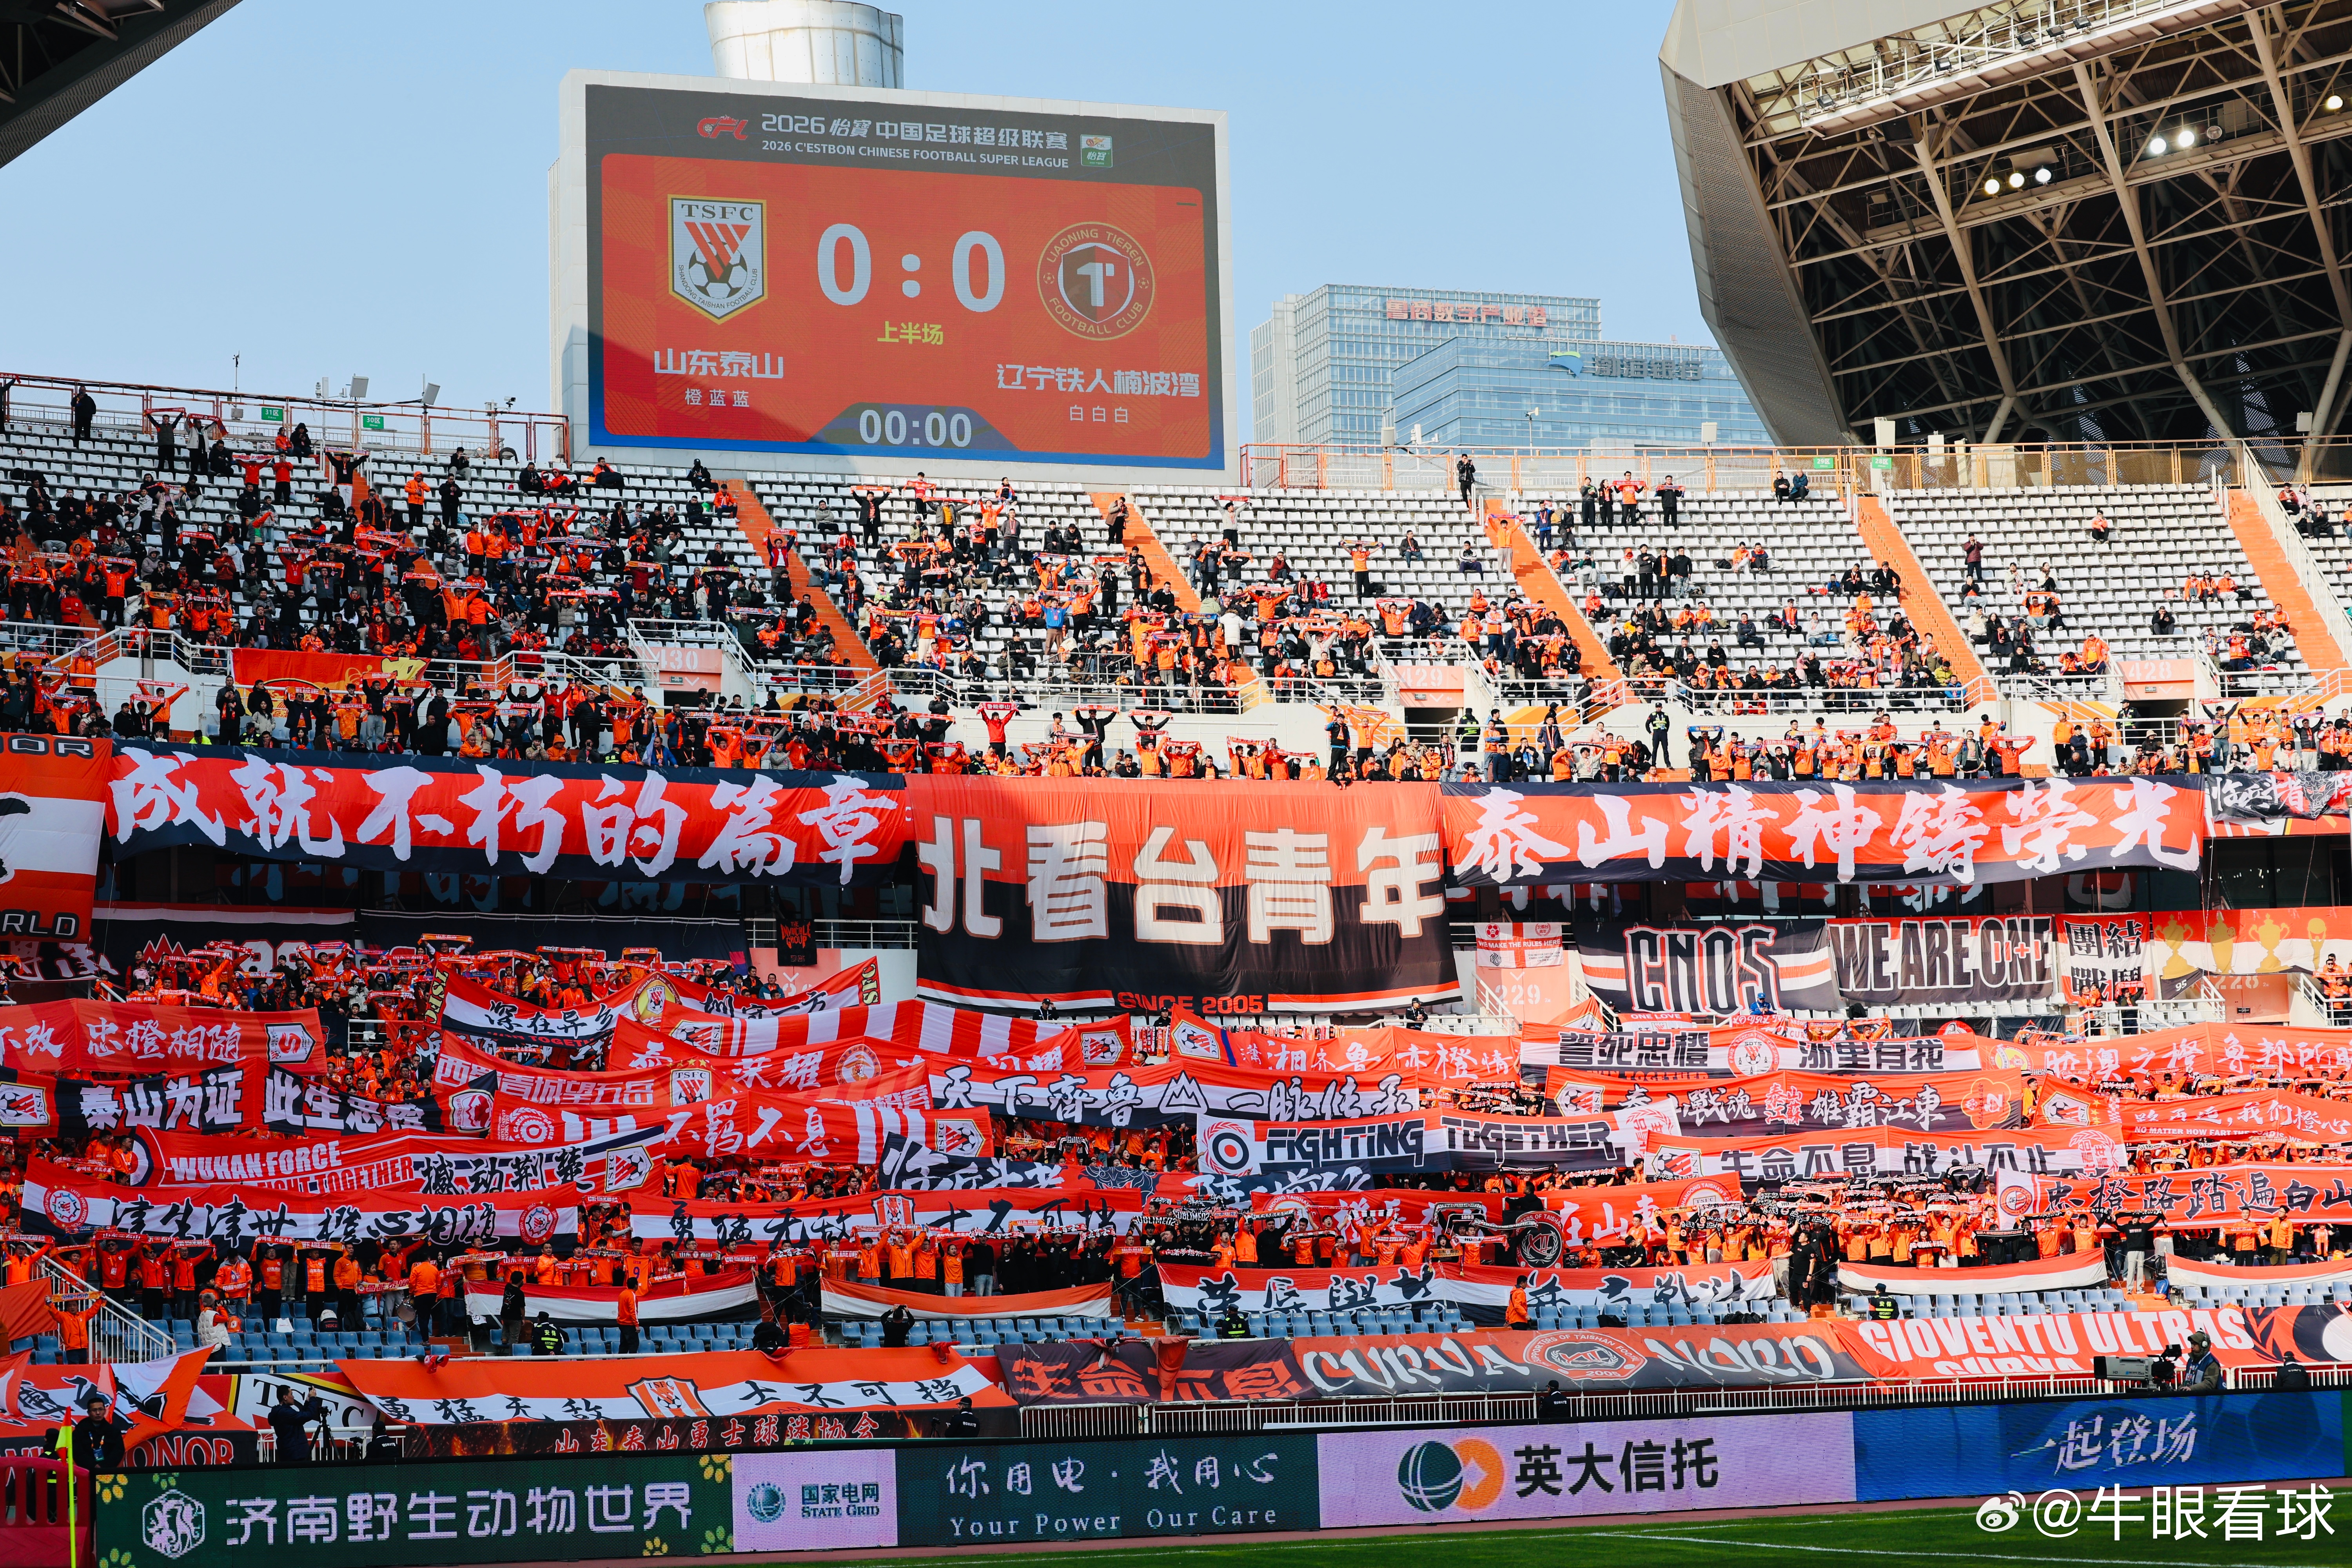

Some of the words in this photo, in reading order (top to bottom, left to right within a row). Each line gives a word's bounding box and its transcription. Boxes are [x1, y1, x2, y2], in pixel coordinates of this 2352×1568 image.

[762, 114, 826, 135] 2026
[876, 121, 1068, 151] 中国足球超级联赛
[762, 140, 792, 151] 2026
[795, 142, 855, 156] C'ESTBON
[858, 146, 911, 158] CHINESE
[913, 150, 977, 163] FOOTBALL
[980, 153, 1019, 166] SUPER
[1021, 156, 1069, 169] LEAGUE
[681, 204, 753, 221] TSFC
[1047, 229, 1098, 263] LIAONING
[1106, 231, 1145, 267] TIEREN
[679, 265, 697, 299] SHANDONG
[698, 297, 725, 309] TAISHAN
[726, 286, 754, 308] FOOTBALL
[877, 321, 945, 346] 上半场
[1049, 298, 1111, 335] FOOTBALL
[1116, 302, 1143, 328] CLUB
[653, 348, 785, 379] 山东泰山
[996, 363, 1201, 398] 辽宁铁人楠波湾
[858, 409, 973, 448] 00:00
[1069, 405, 1130, 425] 白白白
[2128, 661, 2172, 681] 428
[108, 746, 898, 885] 成就不朽的篇章
[918, 815, 1446, 945] 北看台青年
[1837, 924, 1898, 992] WE
[1902, 916, 1973, 991] ARE
[1978, 916, 2053, 989] ONE
[2065, 919, 2142, 958] 團結
[1117, 991, 1194, 1011] SINCE
[1202, 995, 1263, 1014] 2005
[1495, 984, 1540, 1004] 229
[712, 1025, 720, 1053] TSFC
[1558, 1031, 1710, 1068] 誓死忠橙
[80, 1069, 244, 1132] 泰山为证
[1266, 1117, 1425, 1168] FIGHTING
[1439, 1115, 1618, 1165] TOGETHER
[1721, 1140, 1877, 1181] 生命不息
[633, 1267, 640, 1275] 9
[1858, 1315, 2078, 1366] GIOVENTU
[2084, 1309, 2255, 1354] ULTRAS
[1304, 1337, 1530, 1391] CURVA
[1643, 1335, 1835, 1379] NORD
[1585, 1369, 1622, 1378] 2005
[646, 1380, 675, 1389] TSFC
[739, 1379, 965, 1407] 士不可挡
[2010, 1411, 2197, 1477] 一起登场
[1514, 1437, 1719, 1498] 英大信托
[802, 1482, 879, 1504] 国家电网
[225, 1482, 691, 1546] 济南野生动物世界
[950, 1517, 1019, 1536] Your
[1035, 1514, 1120, 1534] Power
[1146, 1510, 1198, 1528] Our
[1210, 1508, 1277, 1525] Care
